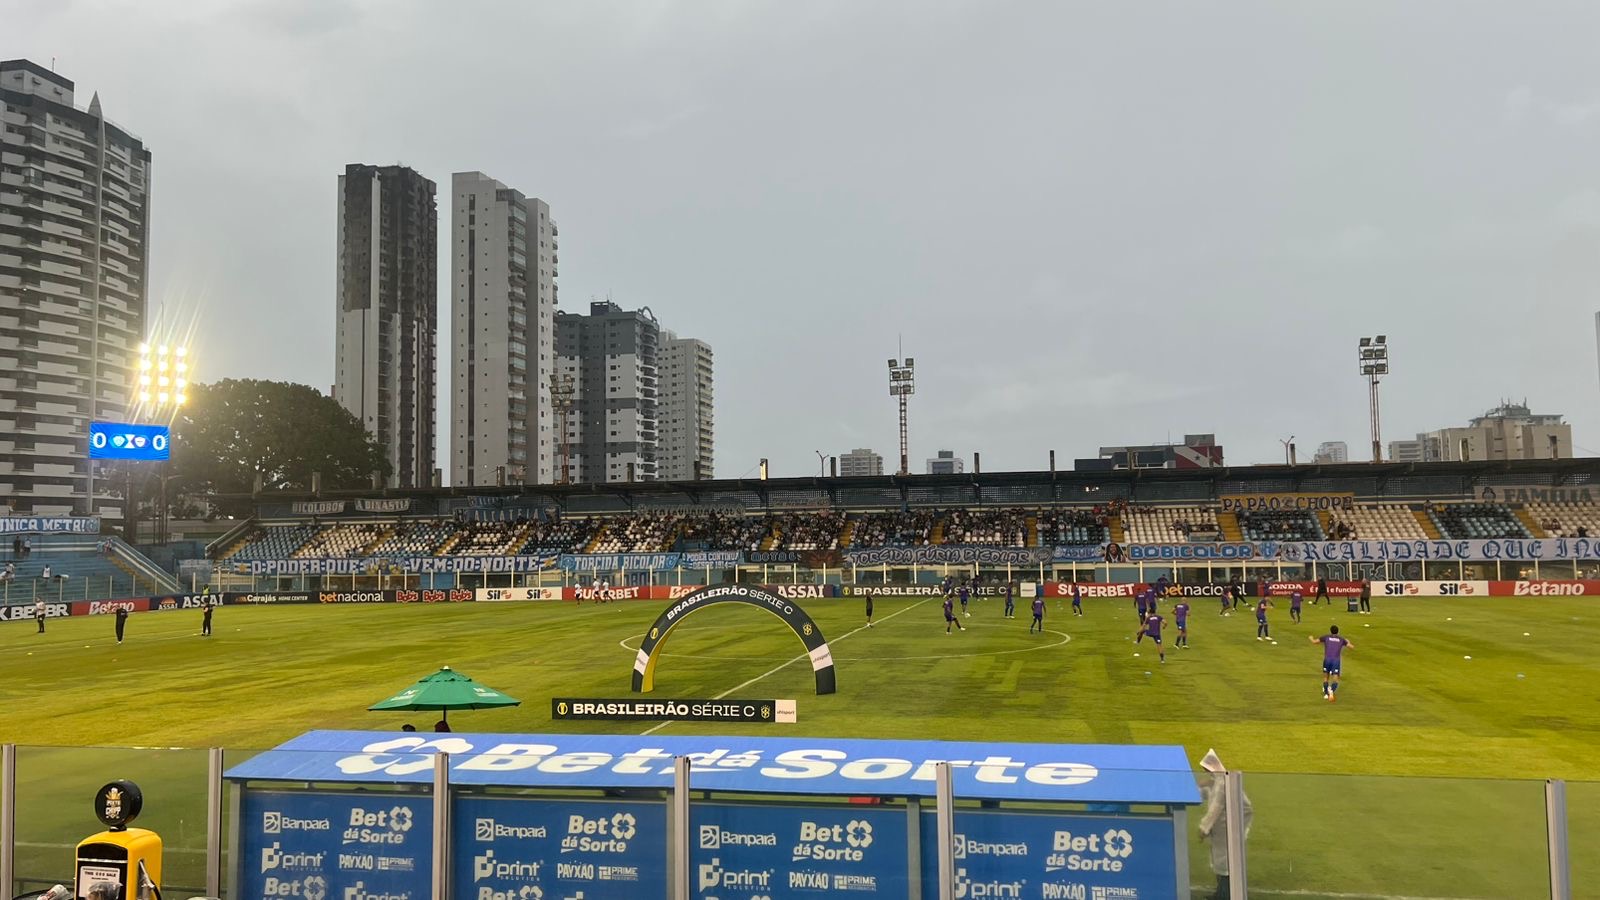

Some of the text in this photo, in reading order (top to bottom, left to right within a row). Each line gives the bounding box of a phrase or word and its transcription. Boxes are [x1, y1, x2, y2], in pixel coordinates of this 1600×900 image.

[93, 432, 166, 451] 0 0
[39, 519, 86, 532] META!
[851, 547, 915, 565] TORCIDA
[963, 547, 1030, 563] BICOLOR
[1302, 541, 1471, 561] REALIDADE
[1482, 540, 1543, 560] QUE
[575, 554, 666, 571] TORCIDA BICOLOR
[320, 591, 384, 602] betnacional
[397, 590, 418, 602] Bob's
[423, 590, 445, 602] Bob's
[450, 590, 472, 602] Bob's
[487, 589, 501, 600] Sil
[527, 588, 541, 600] Sil
[853, 583, 951, 596] BRASILEIRÃ
[1058, 583, 1135, 598] SUPERBET
[1385, 583, 1403, 595] Sil
[1439, 583, 1458, 595] Sil
[1513, 581, 1585, 596] Betano
[247, 594, 277, 603] Carajás
[666, 585, 794, 620] BRASILEIRÃO SÉRIE C
[89, 601, 136, 615] Betano
[573, 701, 755, 717] BRASILEIRÃO SÉRIE C
[453, 743, 1098, 785] Bet dá Sorte
[282, 817, 330, 831] Banpará
[350, 808, 387, 827] Bet
[568, 815, 609, 835] Bet
[344, 828, 405, 844] dá Sorte
[495, 824, 546, 839] Banpará
[721, 831, 777, 847] Banpará
[800, 821, 843, 843] Bet
[562, 836, 627, 853] dá Sorte
[967, 839, 1028, 857] Banpará
[1054, 831, 1101, 852] Bet
[793, 843, 864, 861] dá Sorte
[283, 852, 324, 869] print
[1046, 853, 1123, 872] dá Sorte
[497, 860, 541, 878] print
[265, 877, 301, 896] Bet
[723, 869, 770, 888] print
[847, 876, 876, 884] PRIME
[971, 880, 1022, 898] print
[1107, 888, 1137, 897] PRIME
